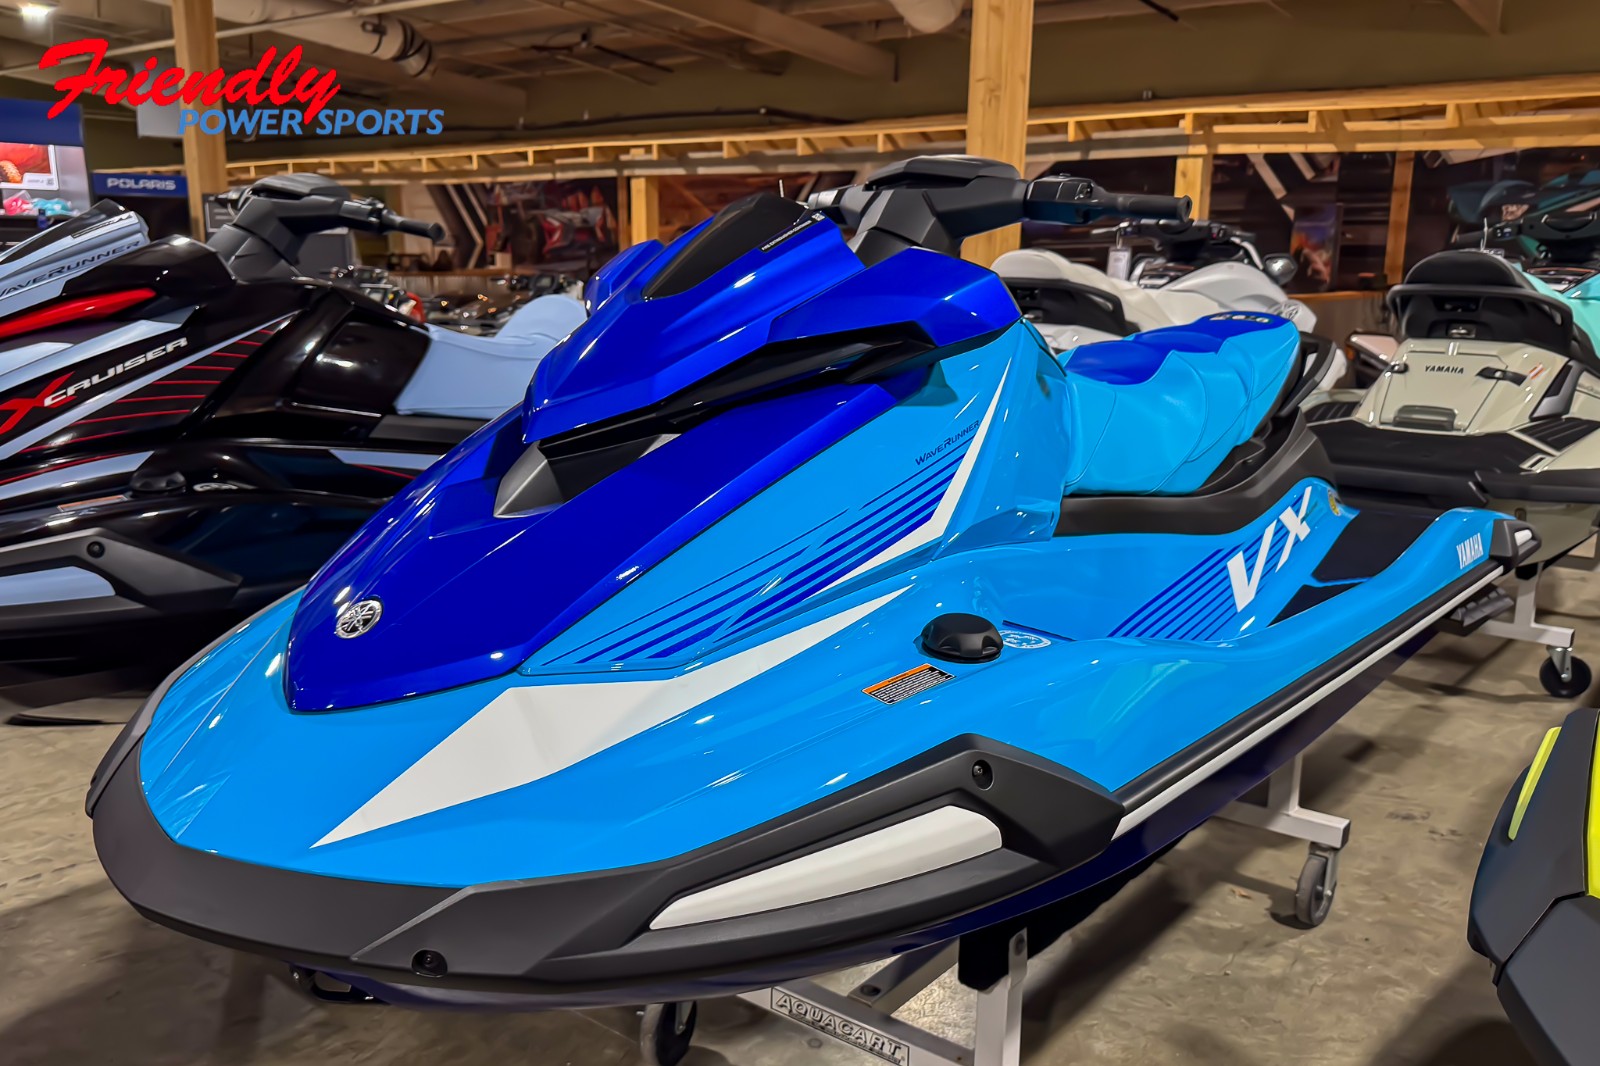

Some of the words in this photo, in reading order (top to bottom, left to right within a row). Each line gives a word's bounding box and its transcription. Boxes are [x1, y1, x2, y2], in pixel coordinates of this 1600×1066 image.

[106, 177, 177, 191] POLARIS
[1424, 365, 1465, 375] YAMAHA
[1226, 485, 1312, 613] VX
[1455, 532, 1484, 570] YAMAHA
[776, 993, 902, 1056] AQUACART
